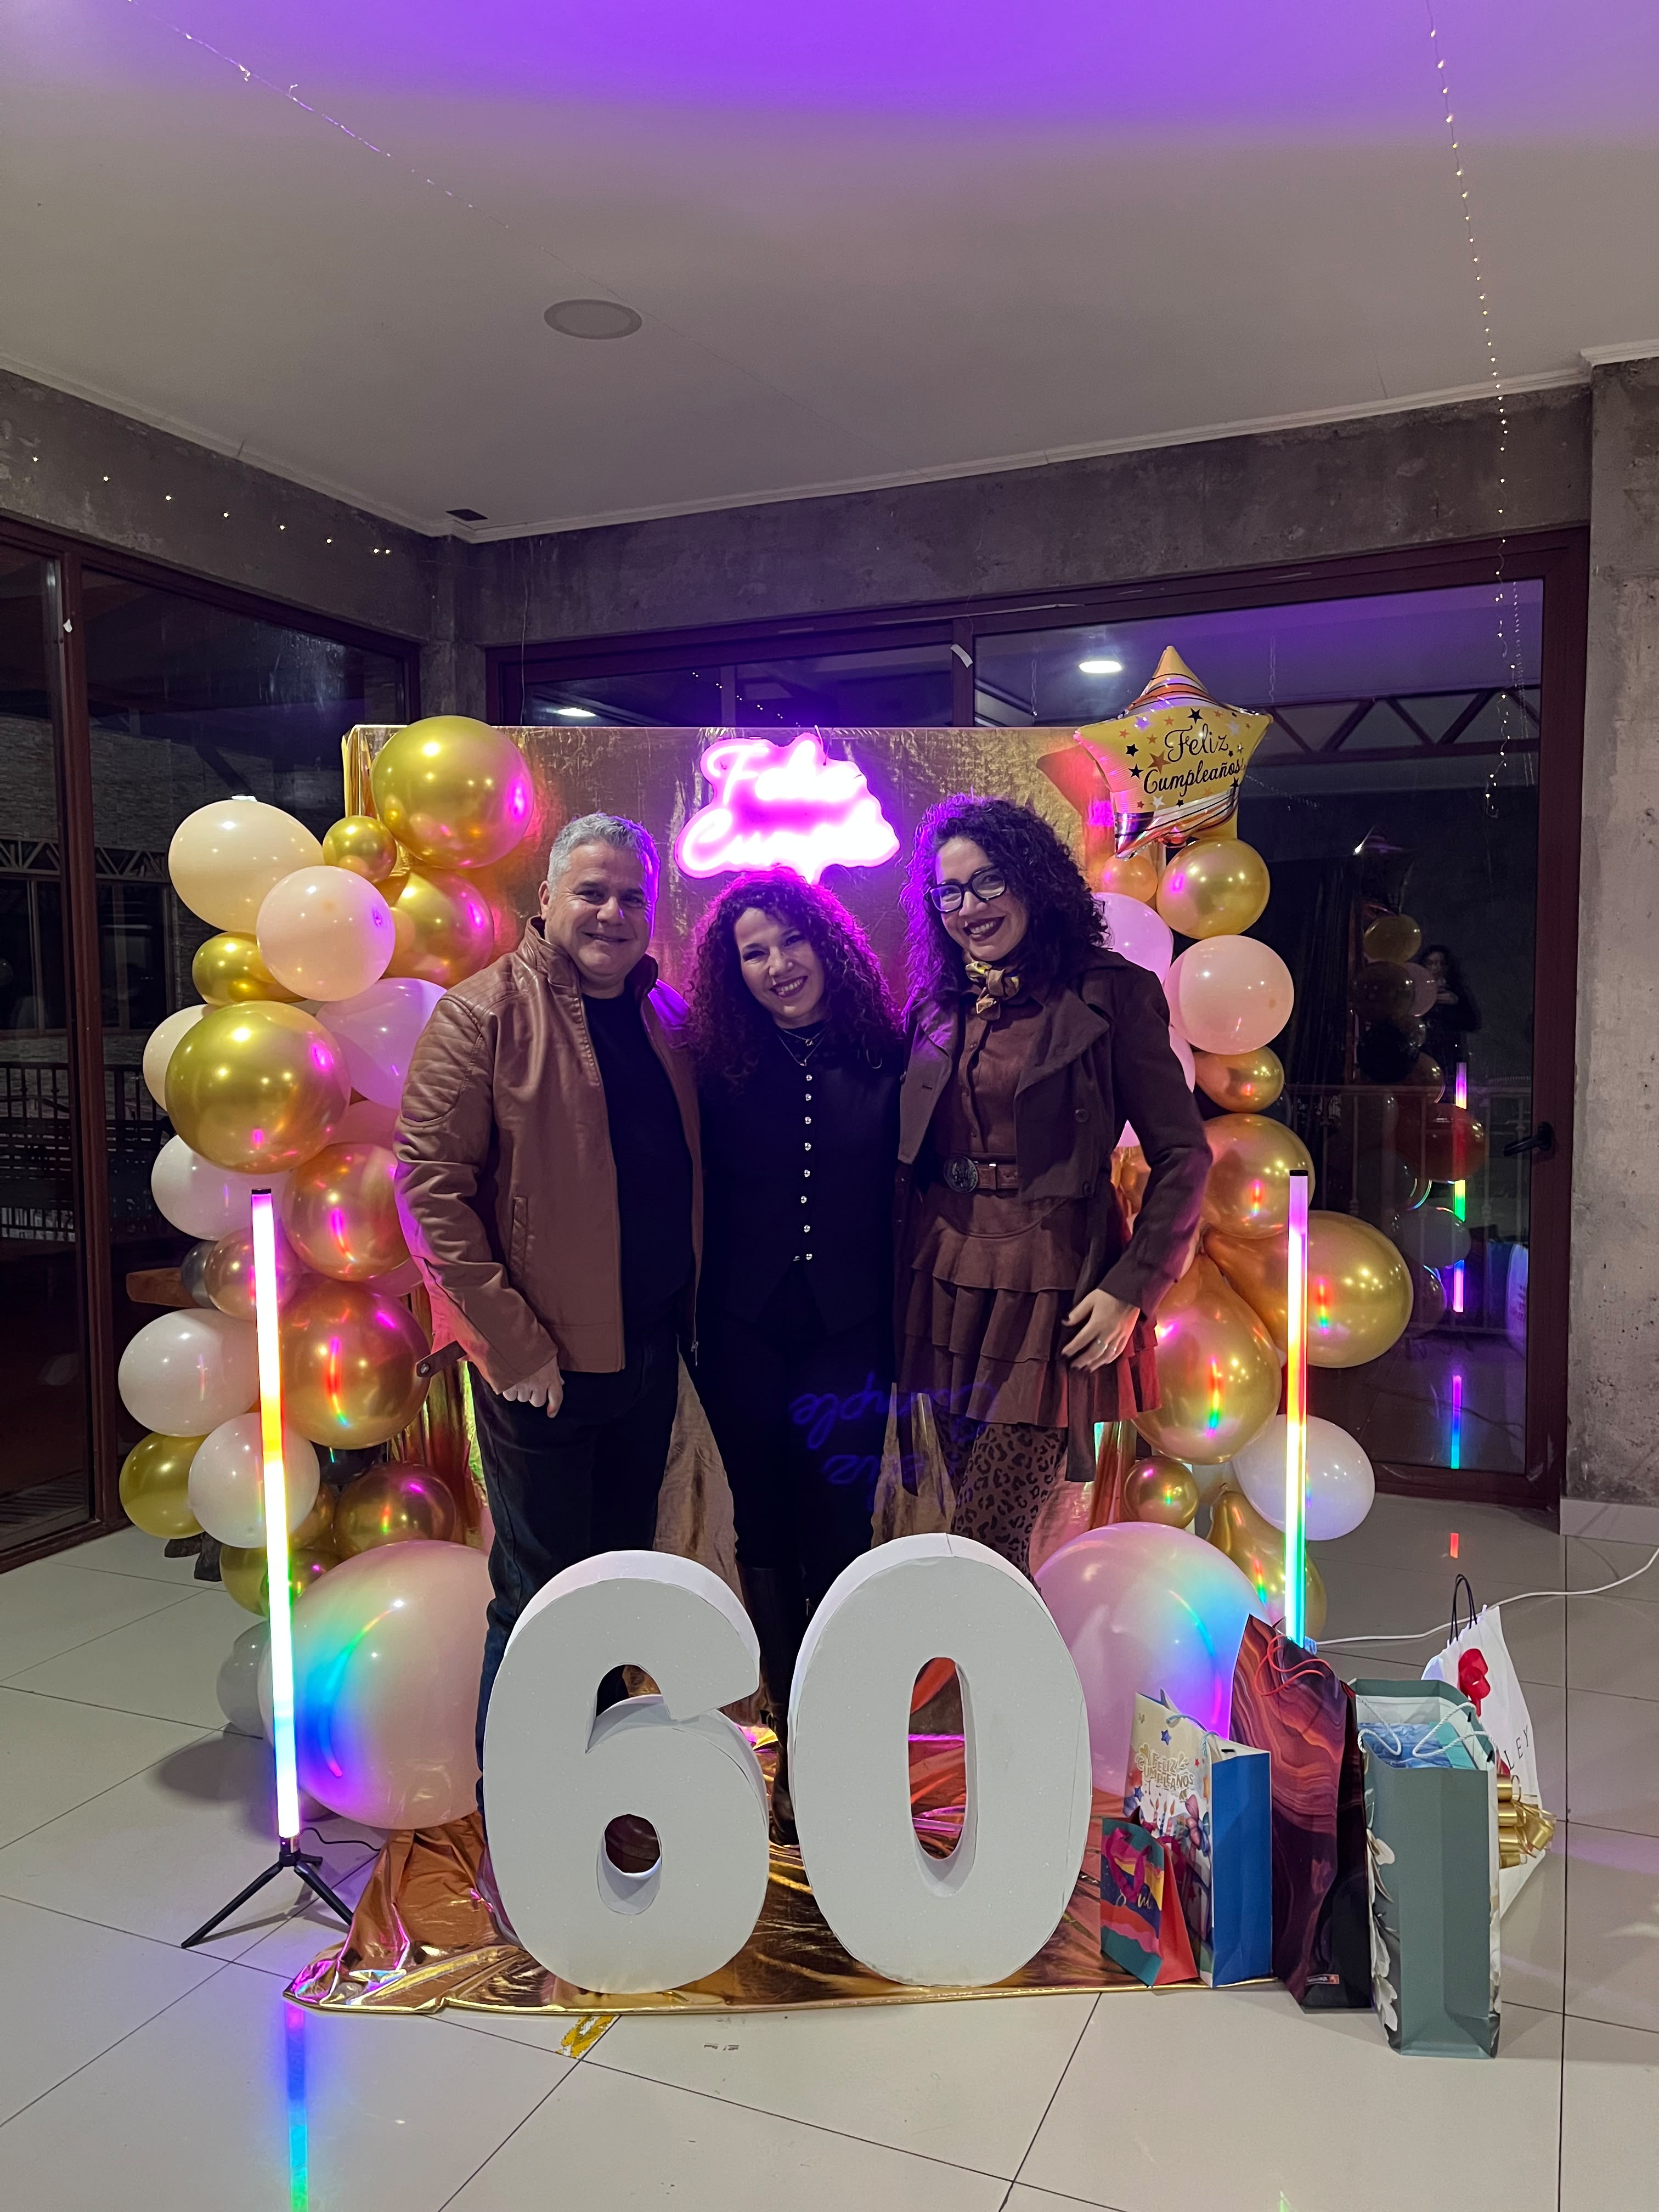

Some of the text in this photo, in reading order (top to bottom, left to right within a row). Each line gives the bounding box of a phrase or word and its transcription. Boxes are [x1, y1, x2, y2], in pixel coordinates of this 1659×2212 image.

[1164, 723, 1229, 763] Feliz
[483, 1533, 1092, 1994] 60
[1151, 1751, 1178, 1773] FELIZ
